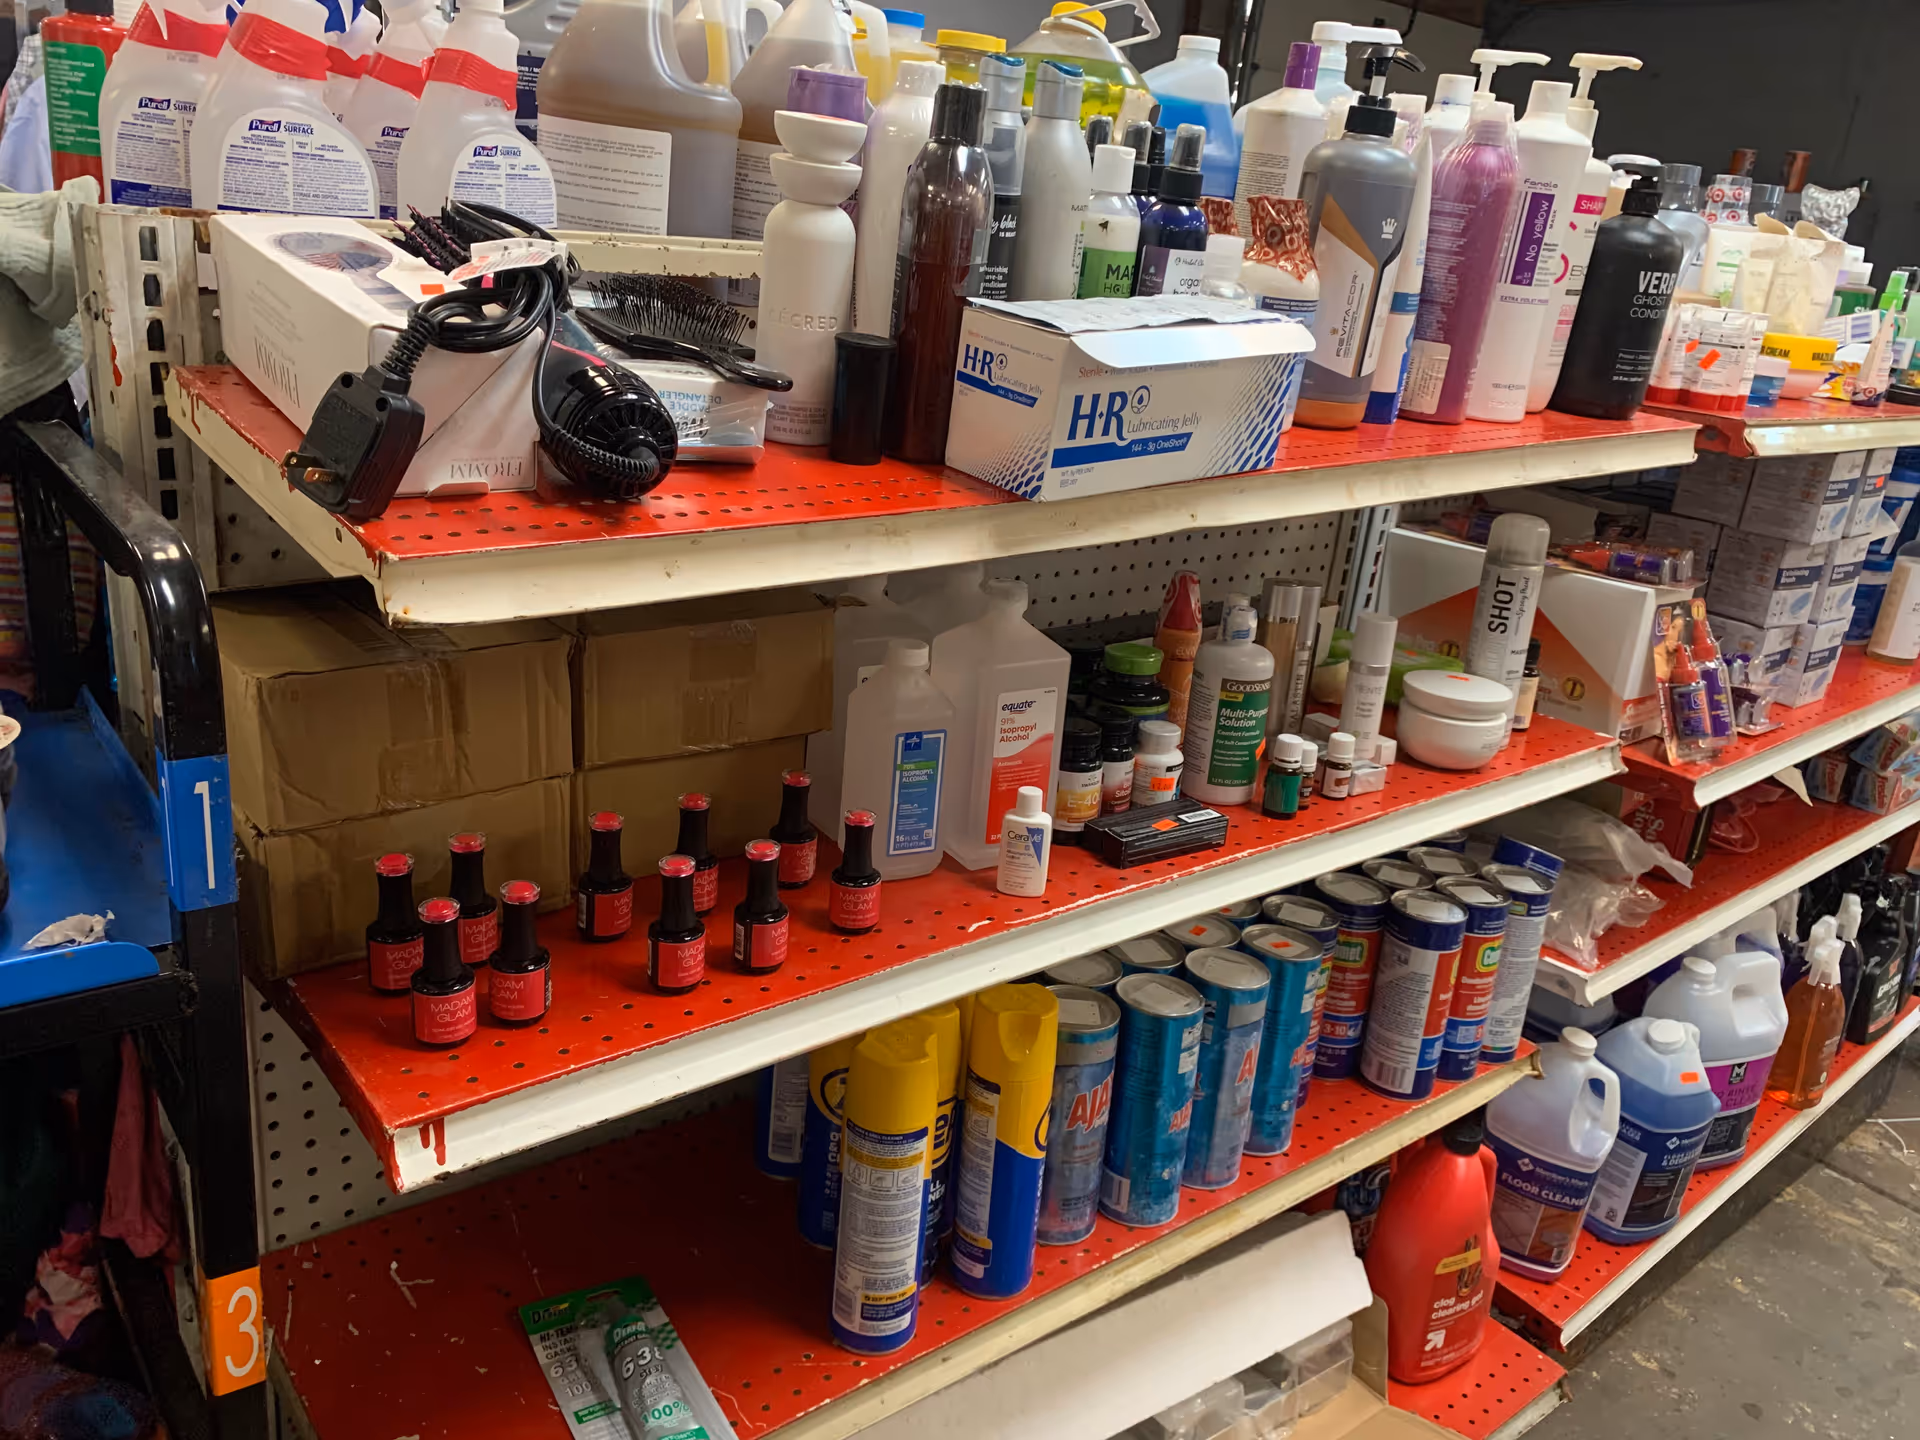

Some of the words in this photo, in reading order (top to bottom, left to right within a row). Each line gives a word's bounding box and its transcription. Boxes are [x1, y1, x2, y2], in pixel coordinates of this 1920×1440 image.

[141, 97, 169, 110] Purell
[173, 103, 197, 112] SURFA
[252, 119, 279, 132] Purell
[284, 124, 314, 135] SURFACE
[476, 145, 498, 158] Purell
[500, 149, 522, 157] SURFACE
[1549, 208, 1558, 229] MASK
[1525, 244, 1538, 262] No
[1532, 200, 1550, 239] yellow
[1179, 277, 1200, 289] orga
[1638, 270, 1678, 294] VERB
[1632, 294, 1668, 306] GHOST
[1766, 346, 1791, 358] CREAM
[1078, 366, 1104, 379] Sterile
[994, 371, 1029, 393] Lubricating
[1028, 384, 1044, 396] Jelly
[657, 390, 722, 406] DETANGLER
[668, 401, 711, 414] PADDLE
[1126, 415, 1180, 435] Lubricating
[1180, 411, 1202, 430] Jelly
[1131, 443, 1144, 453] 144
[1148, 441, 1156, 453] 3g
[449, 462, 523, 480] FROMM
[1487, 575, 1517, 635] SHOT
[1001, 699, 1034, 713] equate
[1000, 716, 1015, 726] 91%
[1218, 717, 1257, 728] Solution
[999, 723, 1037, 736] Isopropyl
[999, 733, 1030, 743] Alcohol
[902, 768, 934, 777] ISOPROPYL
[902, 775, 929, 783] ALCOHOL
[193, 780, 217, 890] 1
[895, 835, 905, 843] 16
[1007, 829, 1042, 843] CeraVe
[839, 891, 876, 902] MADAM
[843, 901, 872, 913] GLAM
[430, 991, 476, 1014] MADAM
[436, 1004, 473, 1024] GLAM
[1501, 1172, 1539, 1195] FLOOR
[1431, 1301, 1471, 1320] clearing
[1471, 1290, 1484, 1308] gel
[1434, 1296, 1456, 1311] clog
[223, 1285, 261, 1378] 3
[565, 1381, 592, 1398] 100
